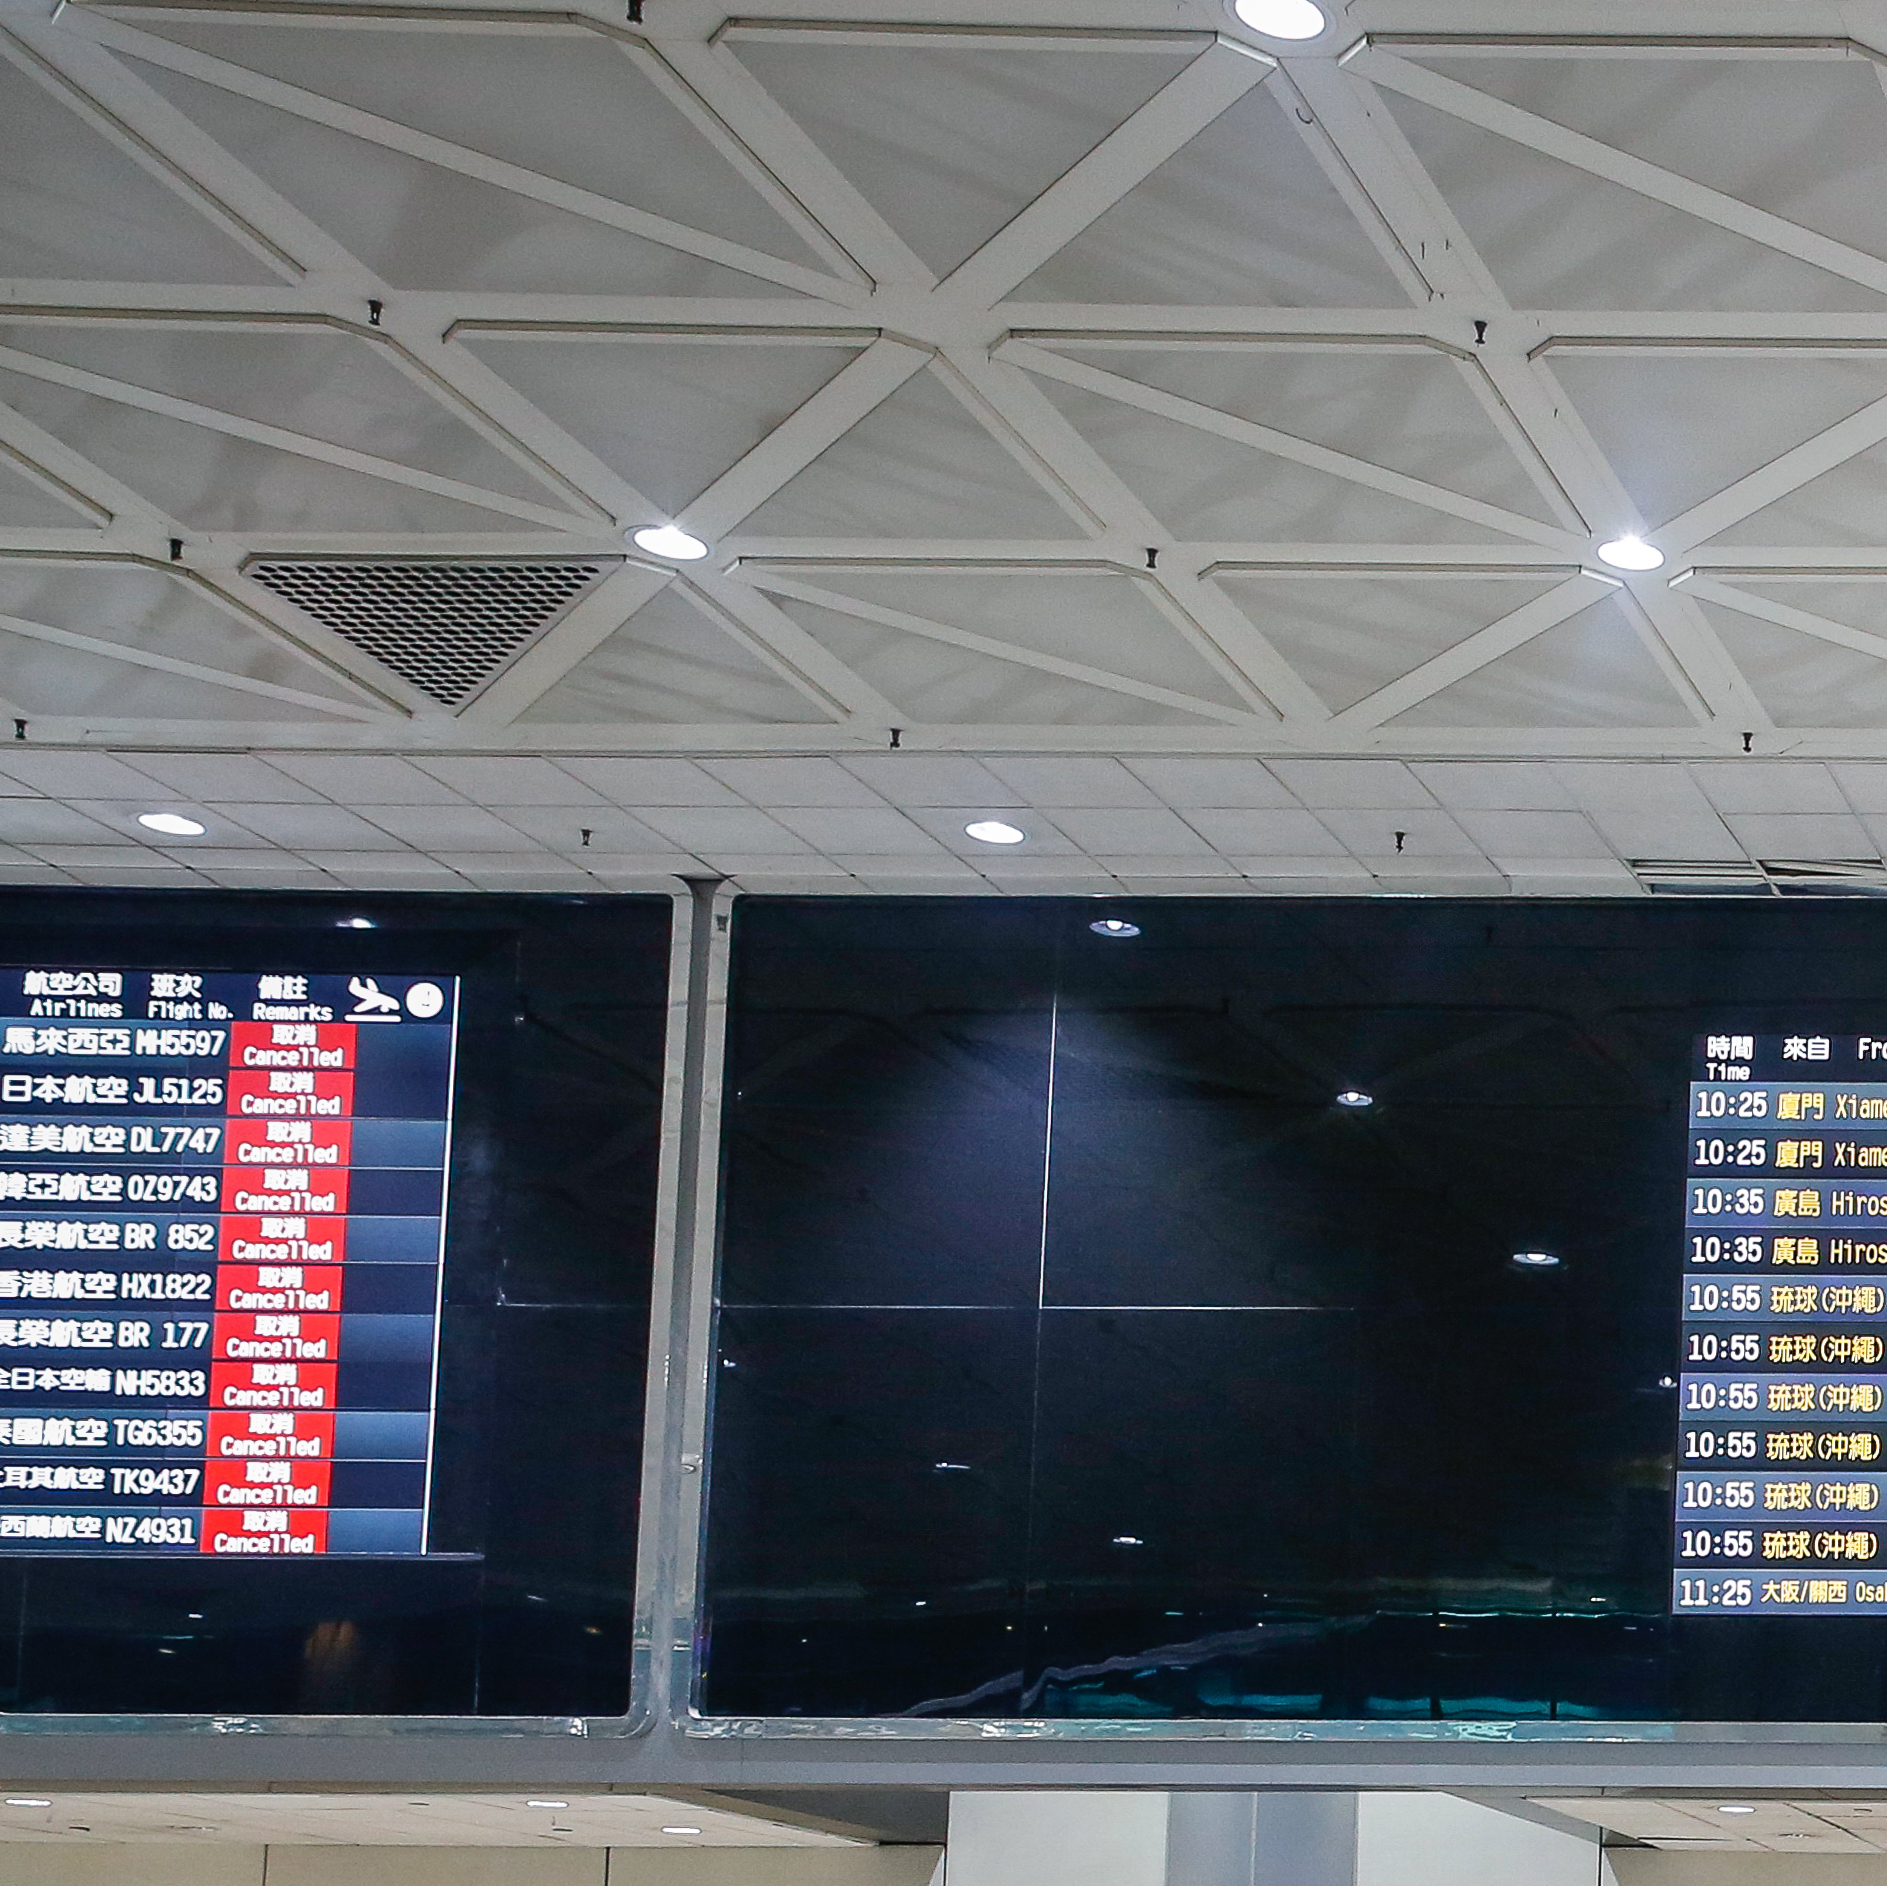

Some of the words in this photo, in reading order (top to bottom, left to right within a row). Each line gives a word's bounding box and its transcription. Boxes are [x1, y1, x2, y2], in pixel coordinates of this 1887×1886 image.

[23, 970, 123, 997] 航空公司
[150, 973, 203, 998] 班次
[258, 974, 308, 1000] 備註
[29, 998, 123, 1018] Airlines
[148, 1000, 203, 1021] Flight
[208, 1001, 234, 1020] No.
[252, 1002, 333, 1022] Remarks
[2, 1026, 131, 1055] 馬來西亞
[135, 1028, 226, 1056] MH5597
[271, 1023, 317, 1046] 取消
[243, 1046, 343, 1067] Cancelled
[1707, 1035, 1754, 1060] 時間
[1783, 1035, 1830, 1061] 來自
[269, 1071, 314, 1094] 取消
[1704, 1062, 1751, 1085] Time
[1, 1074, 129, 1104] 日本航空
[132, 1077, 223, 1105] JL5125
[241, 1091, 341, 1115] Cancelled
[1696, 1091, 1767, 1118] 10:25
[1777, 1092, 1824, 1120] 廈門
[1693, 1188, 1764, 1214] 10:35
[1773, 1188, 1821, 1217] 廣島
[1688, 1334, 1760, 1361] 10:55
[1769, 1335, 1883, 1364] 琉球(沖繩)
[1685, 1431, 1756, 1458] 10:55
[1766, 1432, 1880, 1461] 琉球(沖繩)
[1679, 1579, 1752, 1606] 11:25
[1760, 1579, 1848, 1603] 大阪/關西
